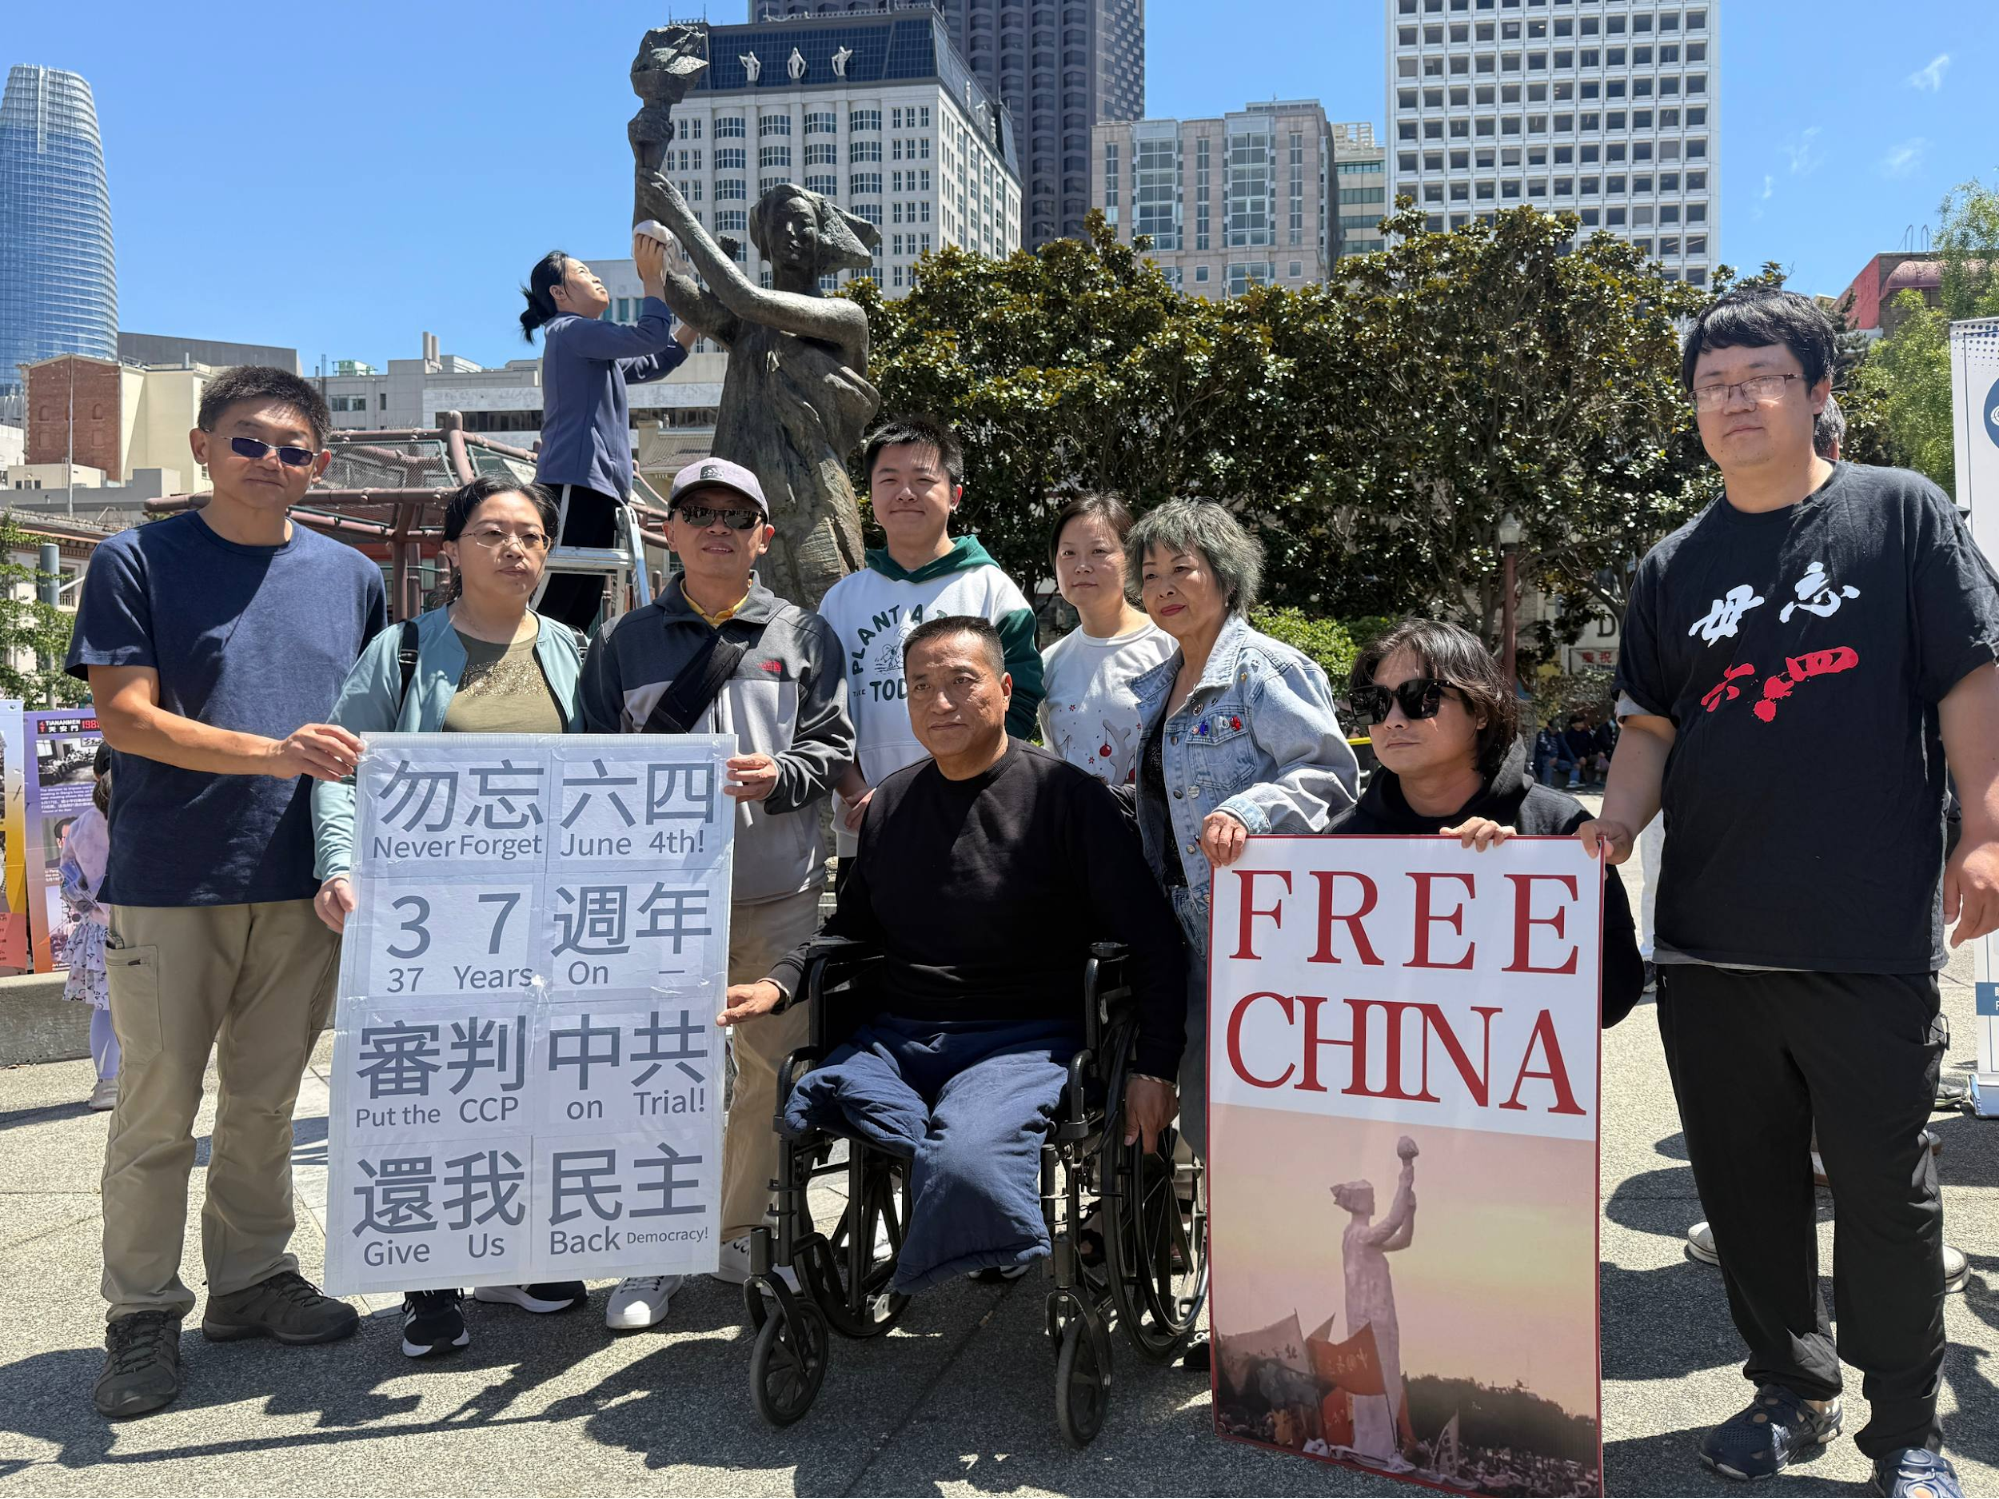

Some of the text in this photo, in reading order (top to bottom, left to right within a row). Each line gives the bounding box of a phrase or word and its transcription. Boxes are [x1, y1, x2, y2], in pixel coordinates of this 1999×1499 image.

[852, 604, 923, 676] PLANT A
[869, 678, 908, 702] TOD
[373, 829, 703, 860] Never Forget June 4th!
[1228, 869, 1579, 974] FREE
[387, 968, 424, 992] 37
[454, 966, 532, 989] Years
[569, 961, 608, 985] On
[1227, 991, 1586, 1115] CHINA
[357, 1084, 704, 1127] Put the CCP on Trial!
[364, 1227, 707, 1266] Give Us Back Democracy!
